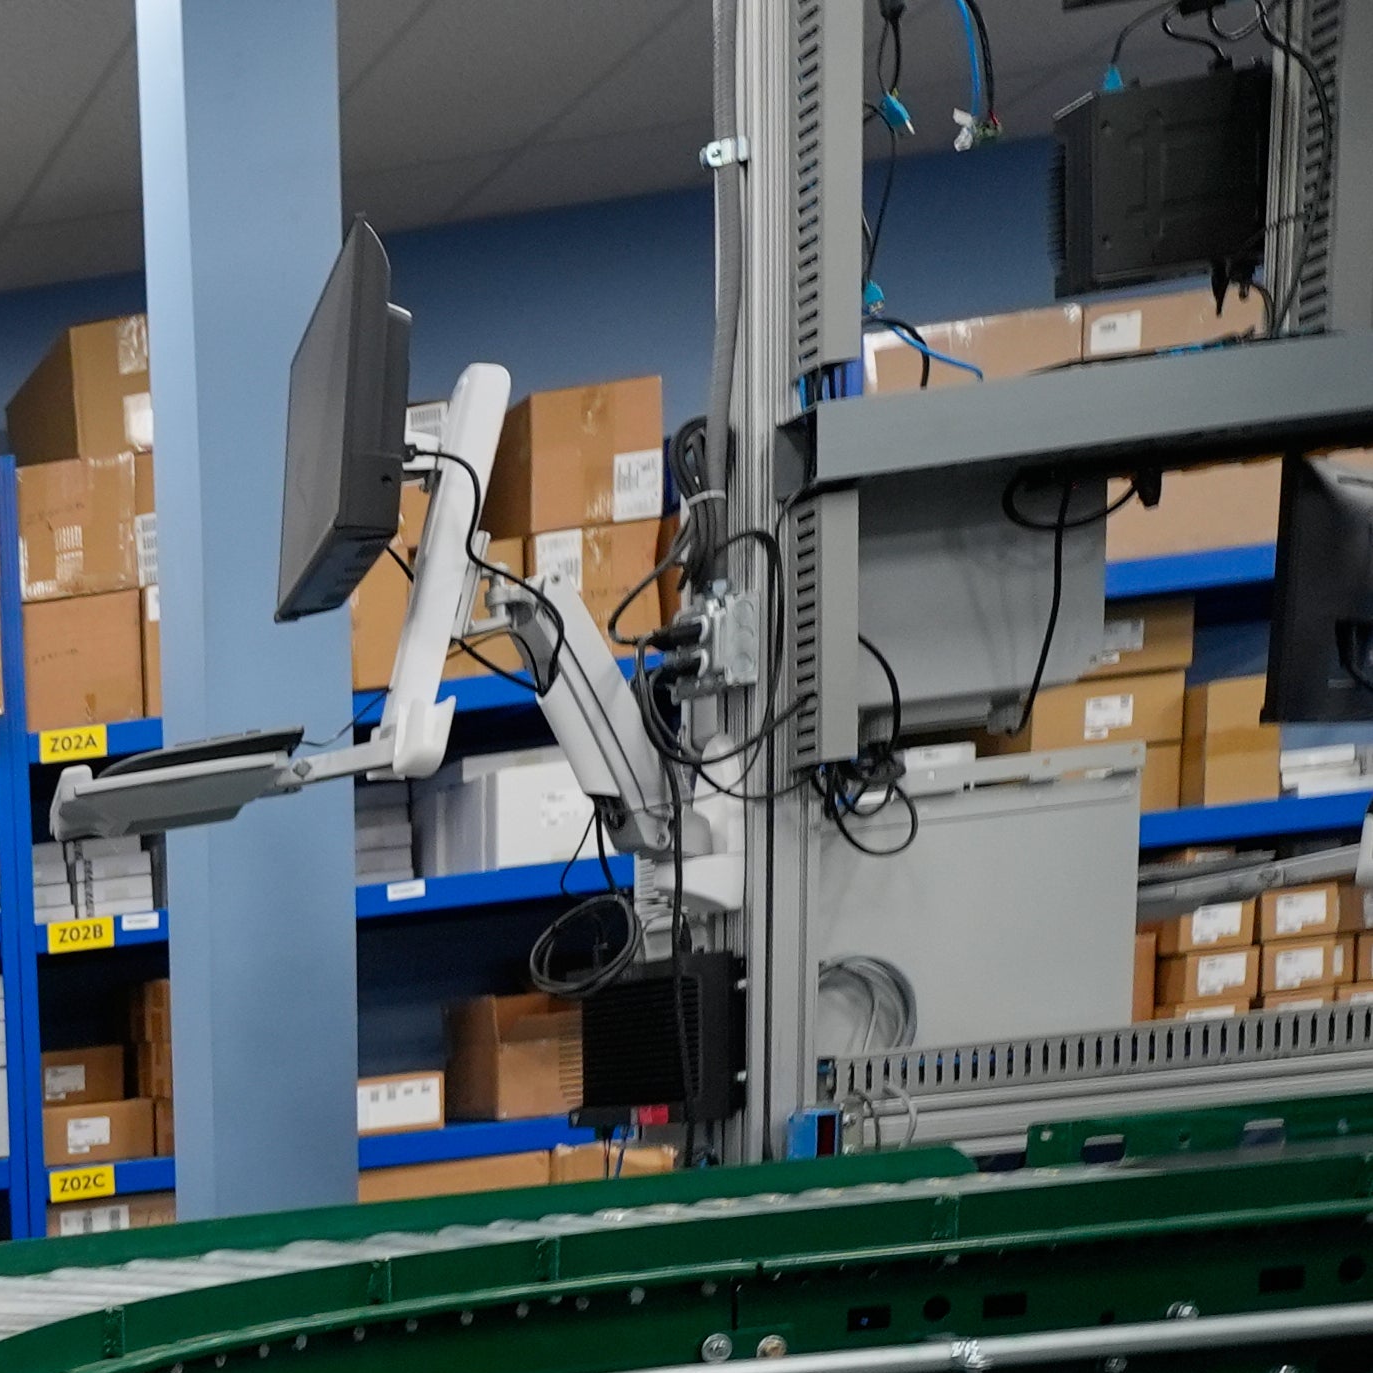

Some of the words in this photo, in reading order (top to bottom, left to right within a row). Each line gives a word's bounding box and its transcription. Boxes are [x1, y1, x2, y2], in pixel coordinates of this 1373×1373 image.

[50, 734, 97, 753] Z02A
[58, 924, 103, 943] Z02B
[60, 1173, 105, 1192] Z02C
